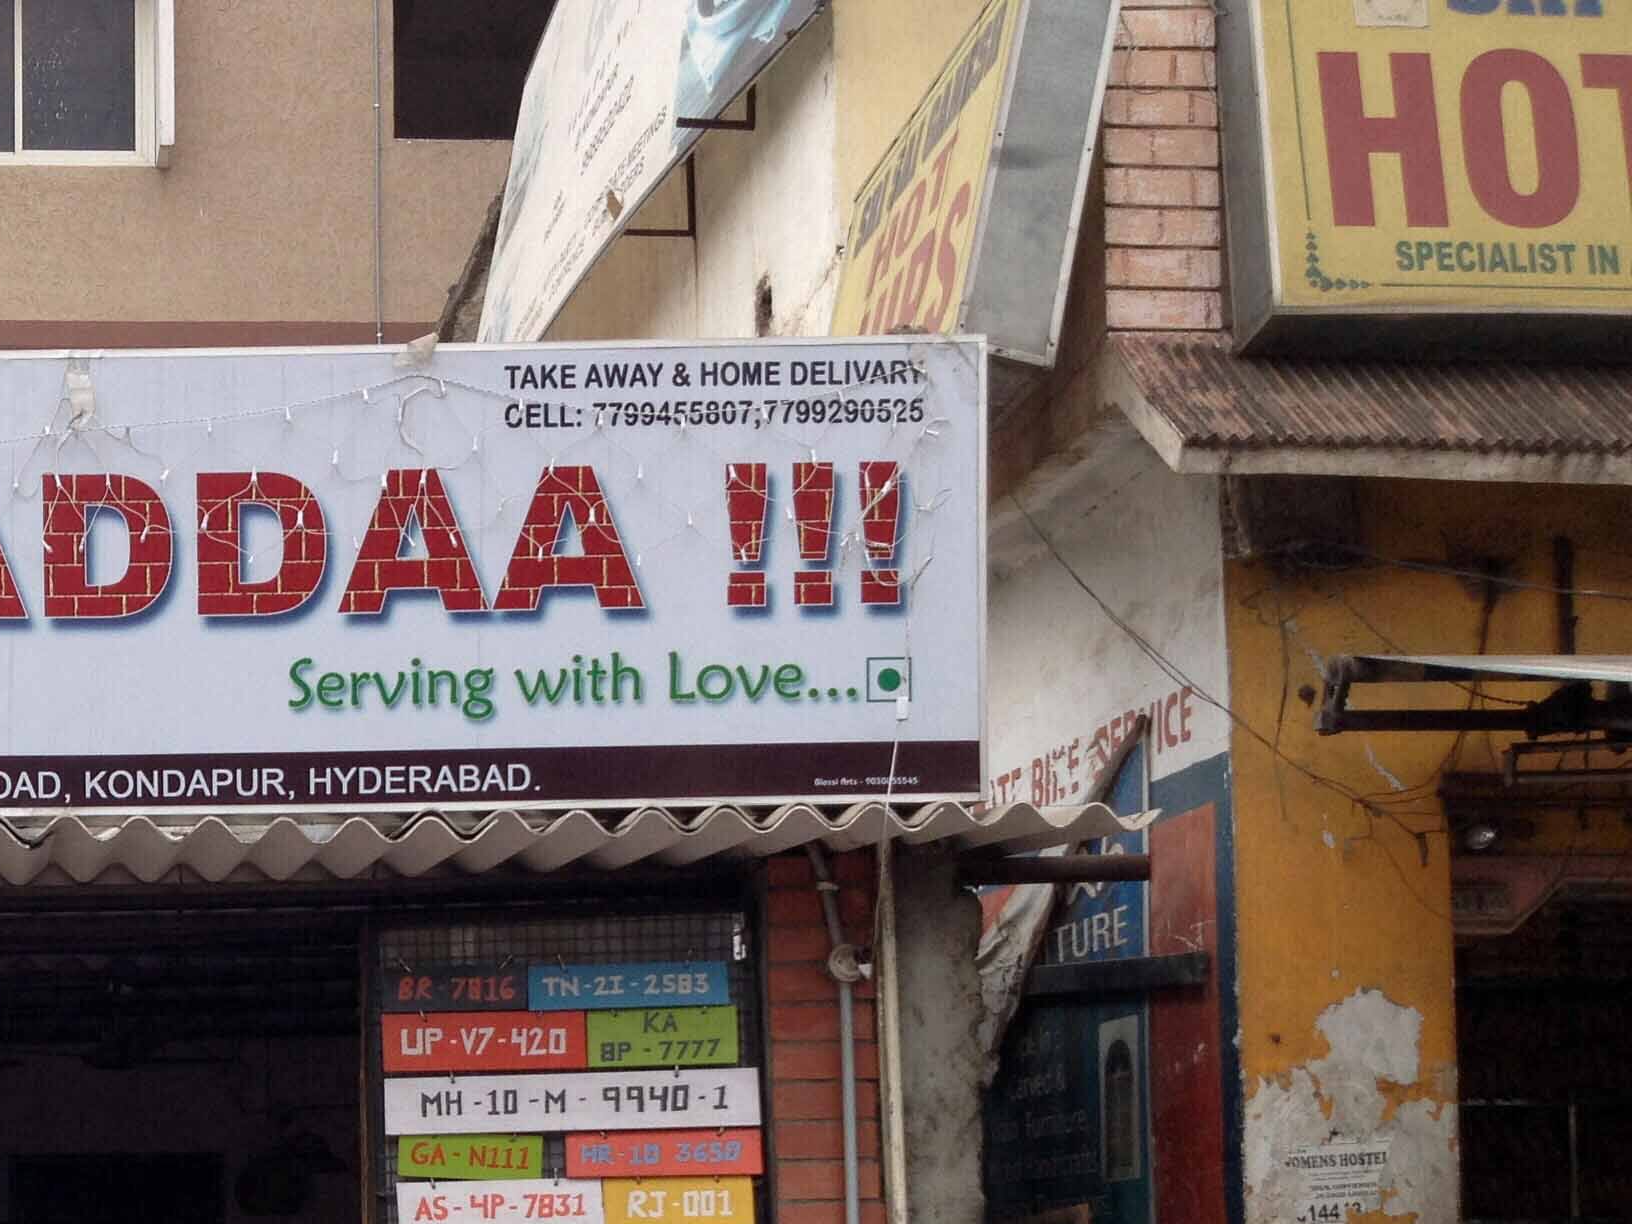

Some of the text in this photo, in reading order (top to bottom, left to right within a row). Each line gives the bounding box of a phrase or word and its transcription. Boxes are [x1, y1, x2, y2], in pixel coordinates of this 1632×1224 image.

[1395, 241, 1619, 274] SPECIALIST IN
[504, 360, 926, 389] TAKE AWAY & HOME DELIVARY
[504, 402, 582, 428] CELL:
[725, 460, 901, 608] !!!
[288, 657, 496, 721] Serving
[514, 654, 642, 704] with
[83, 768, 294, 801] KONDAPUR,
[308, 764, 541, 796] HYDERABAD.
[642, 1012, 678, 1035] KA
